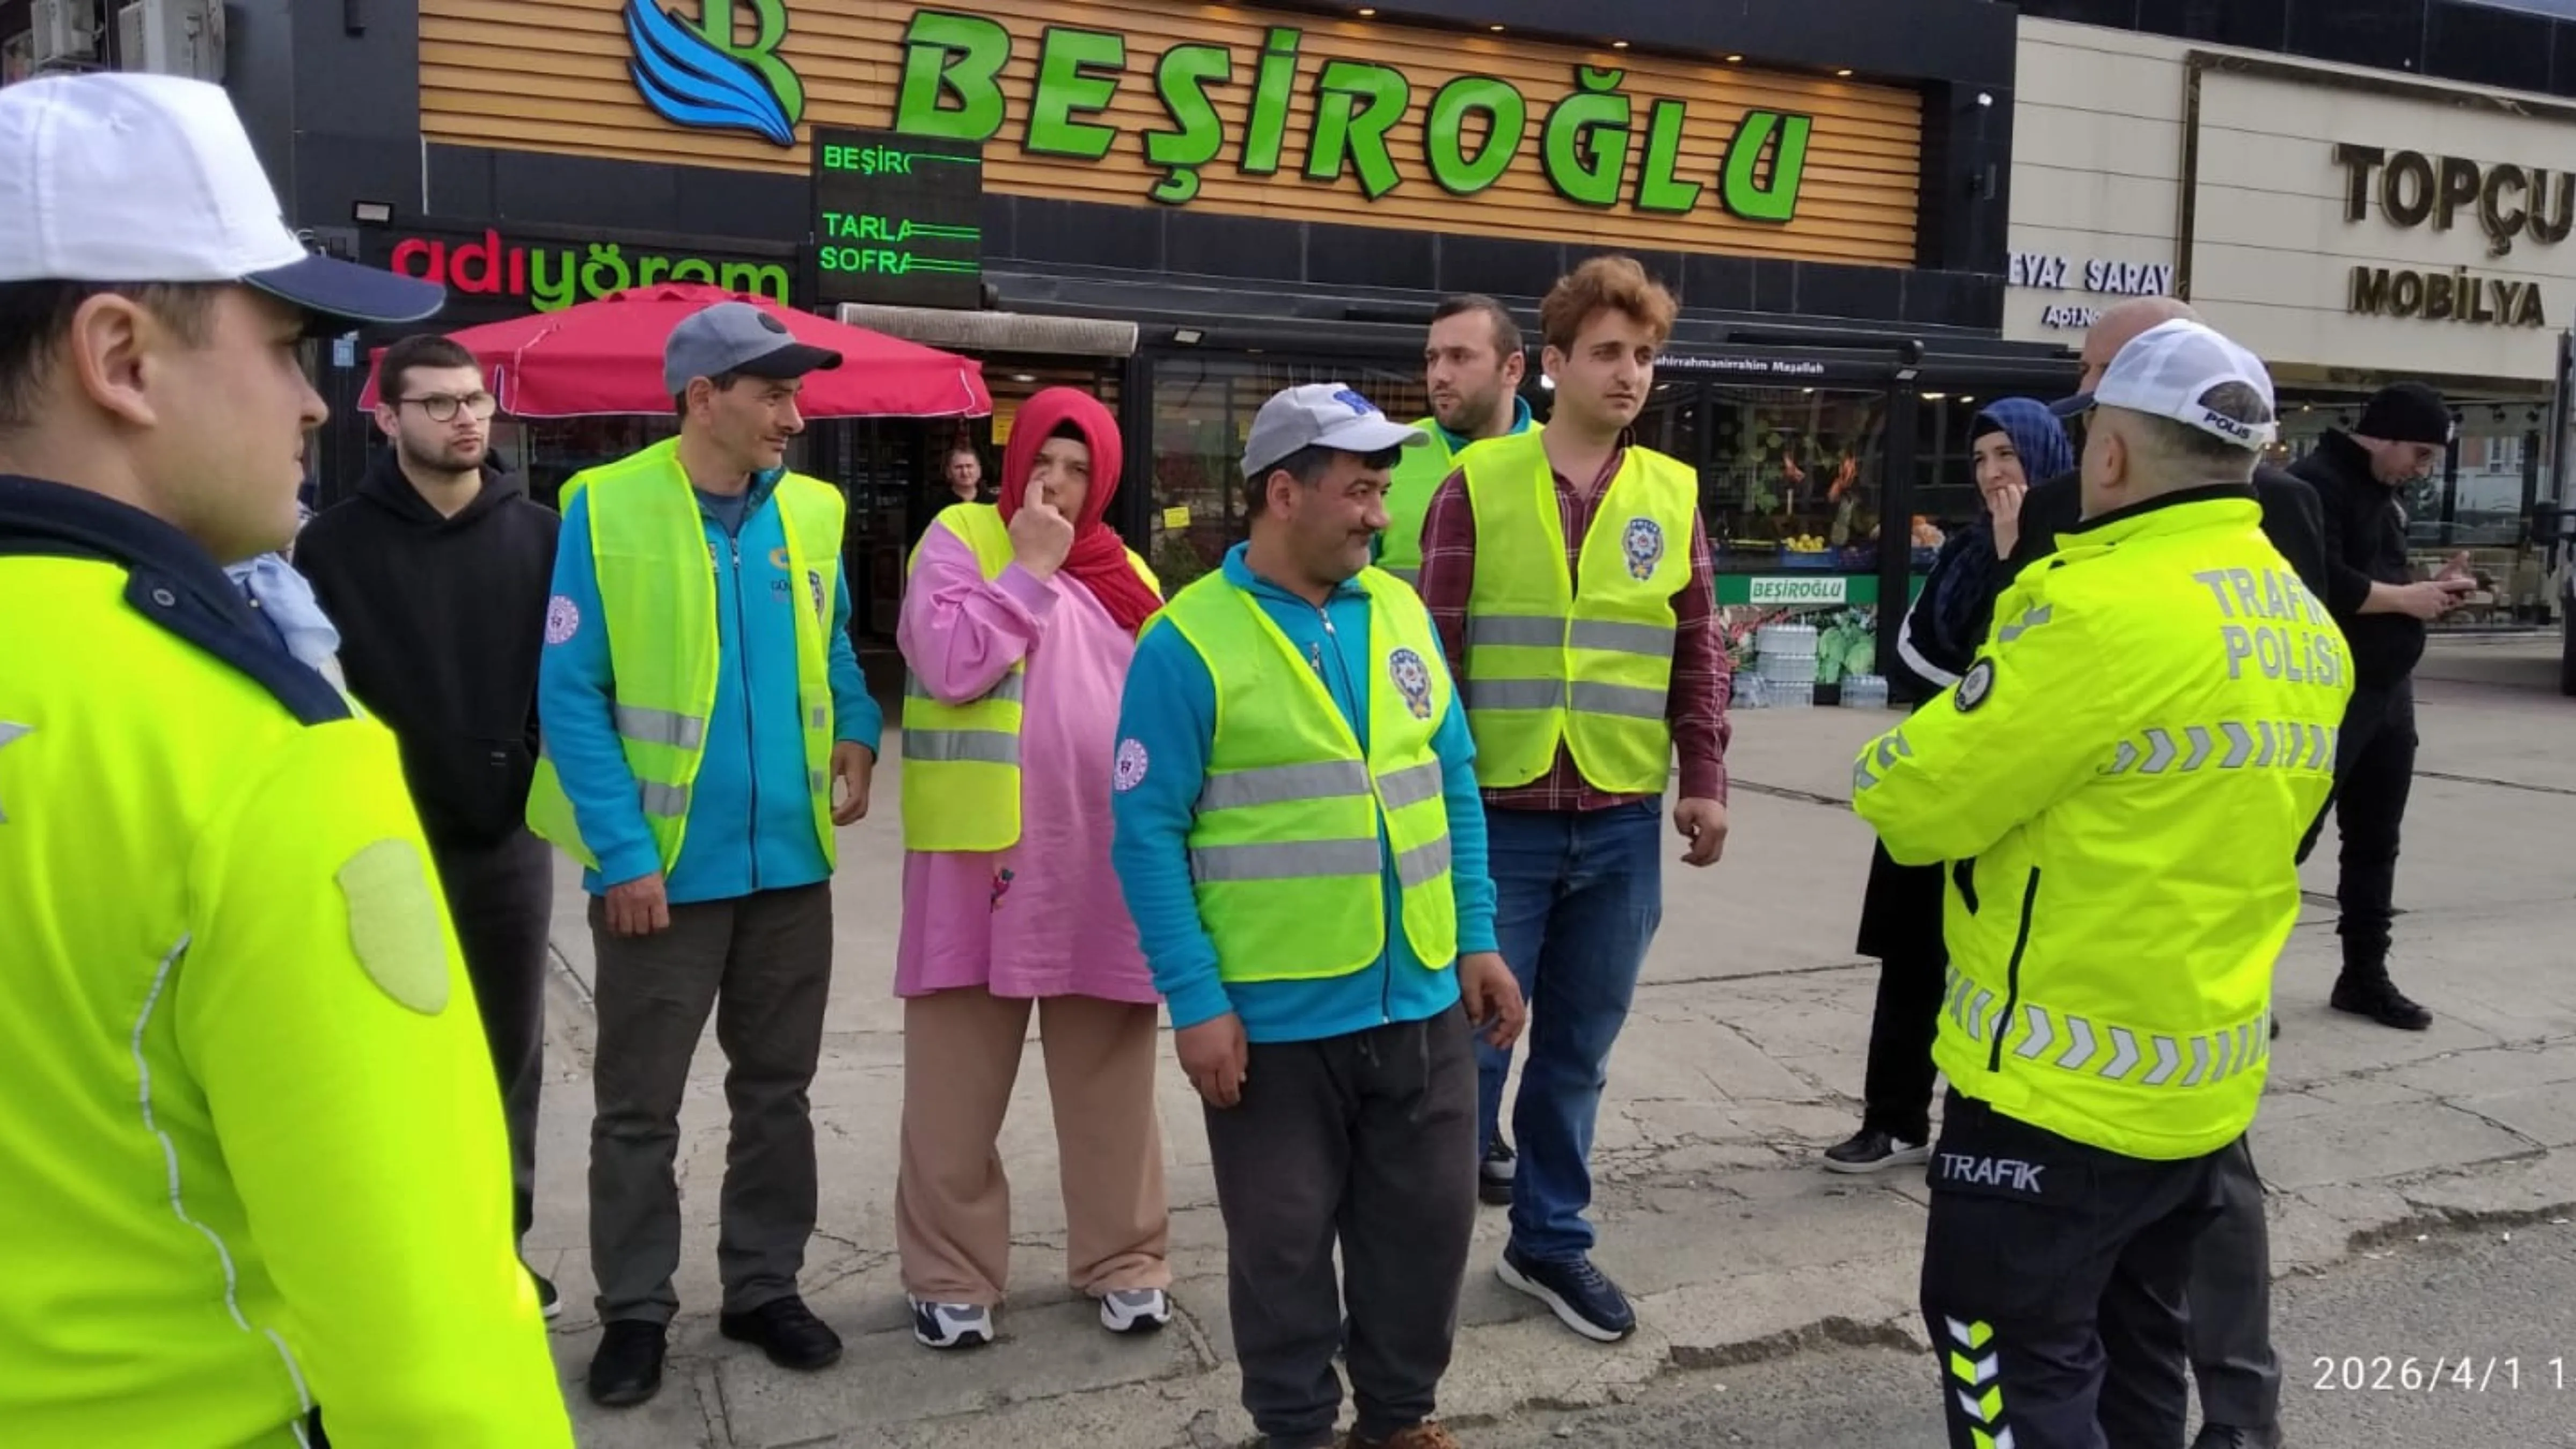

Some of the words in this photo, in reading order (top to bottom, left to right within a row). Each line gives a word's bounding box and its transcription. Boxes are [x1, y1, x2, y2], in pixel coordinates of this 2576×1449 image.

[894, 10, 1812, 223] BEŞİROĞLU
[822, 213, 912, 242] TARLA
[2332, 143, 2576, 257] TOPÇU
[2009, 253, 2071, 287] EYAZ
[2085, 259, 2174, 295] SARAY
[2348, 265, 2545, 326] MOBİLYA
